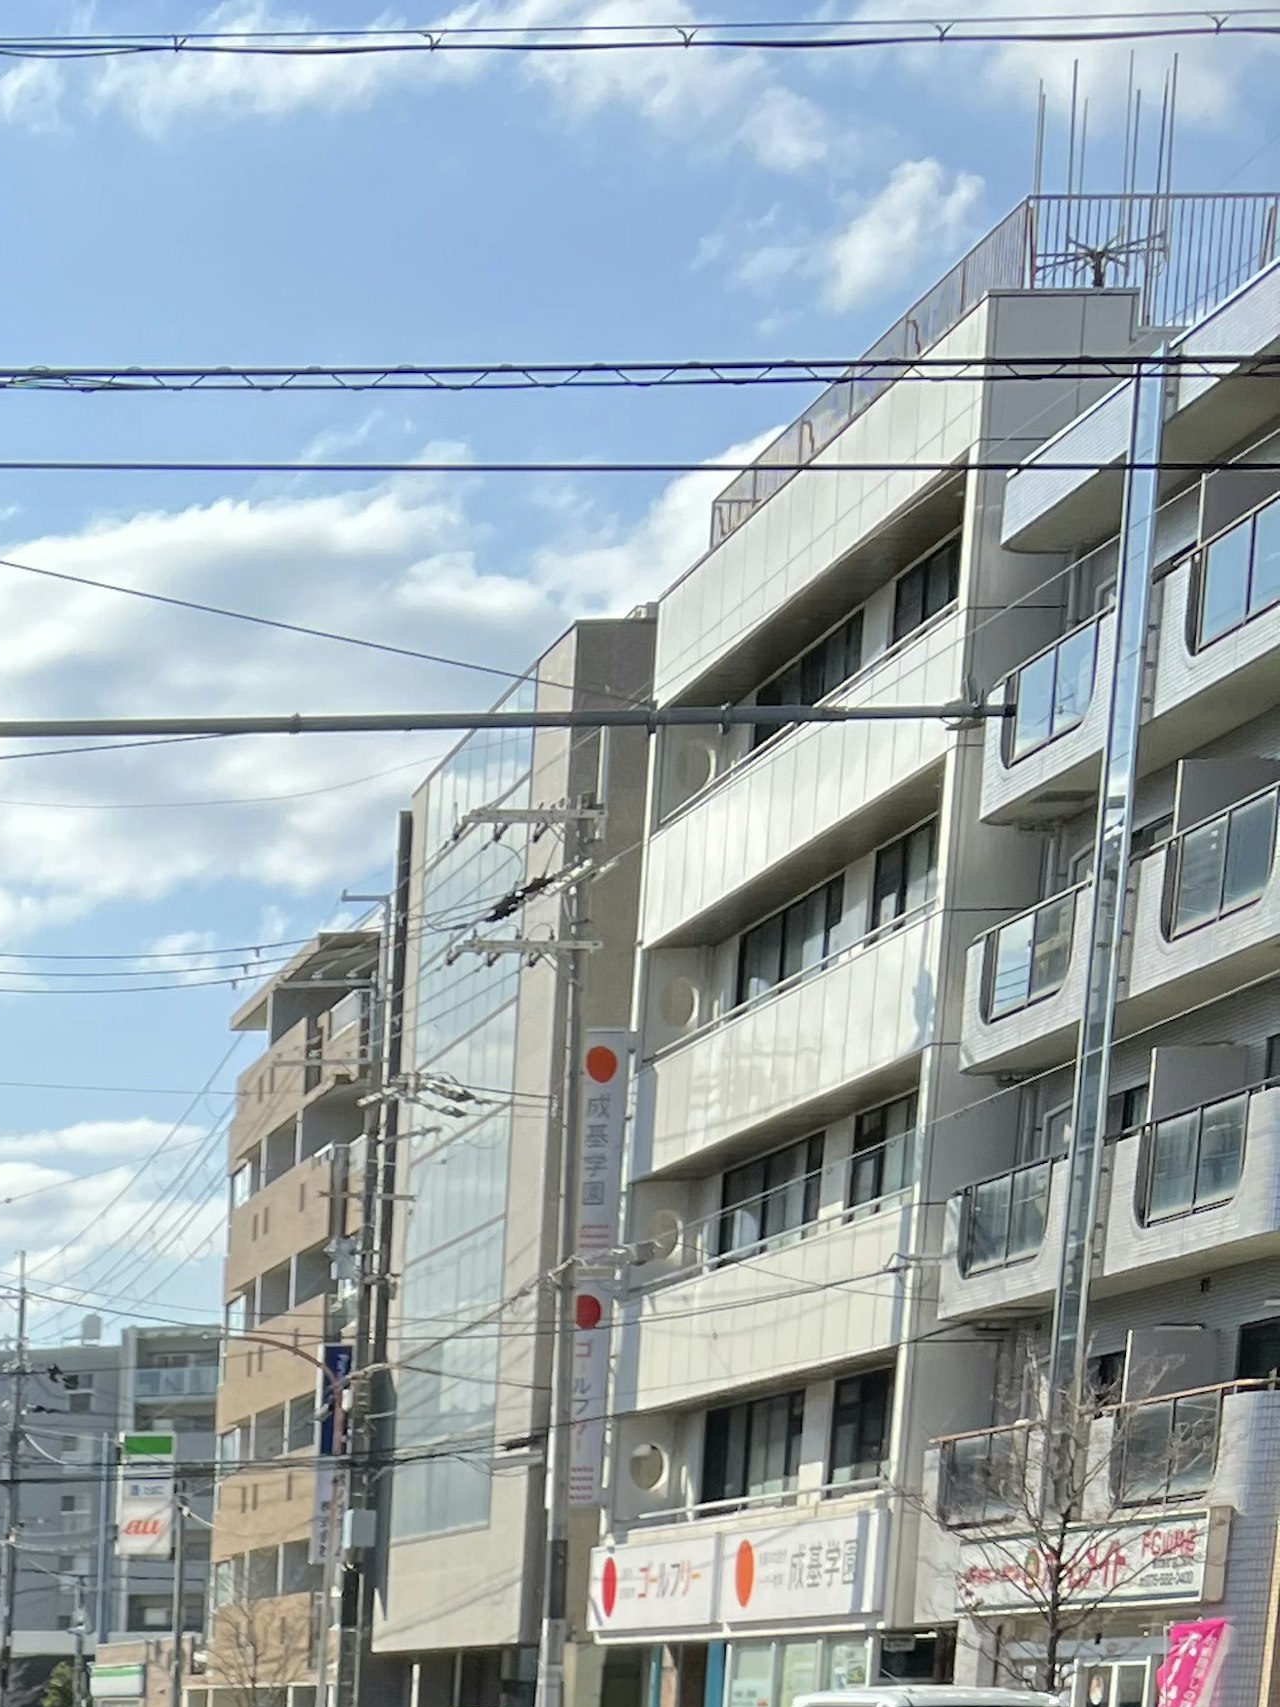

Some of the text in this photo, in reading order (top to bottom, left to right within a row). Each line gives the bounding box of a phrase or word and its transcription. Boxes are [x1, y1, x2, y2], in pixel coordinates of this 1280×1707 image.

[582, 1094, 612, 1205] 成基学園
[123, 1518, 164, 1535] au
[637, 1559, 702, 1600] ゴールフリー
[787, 1538, 858, 1591] 成基学園
